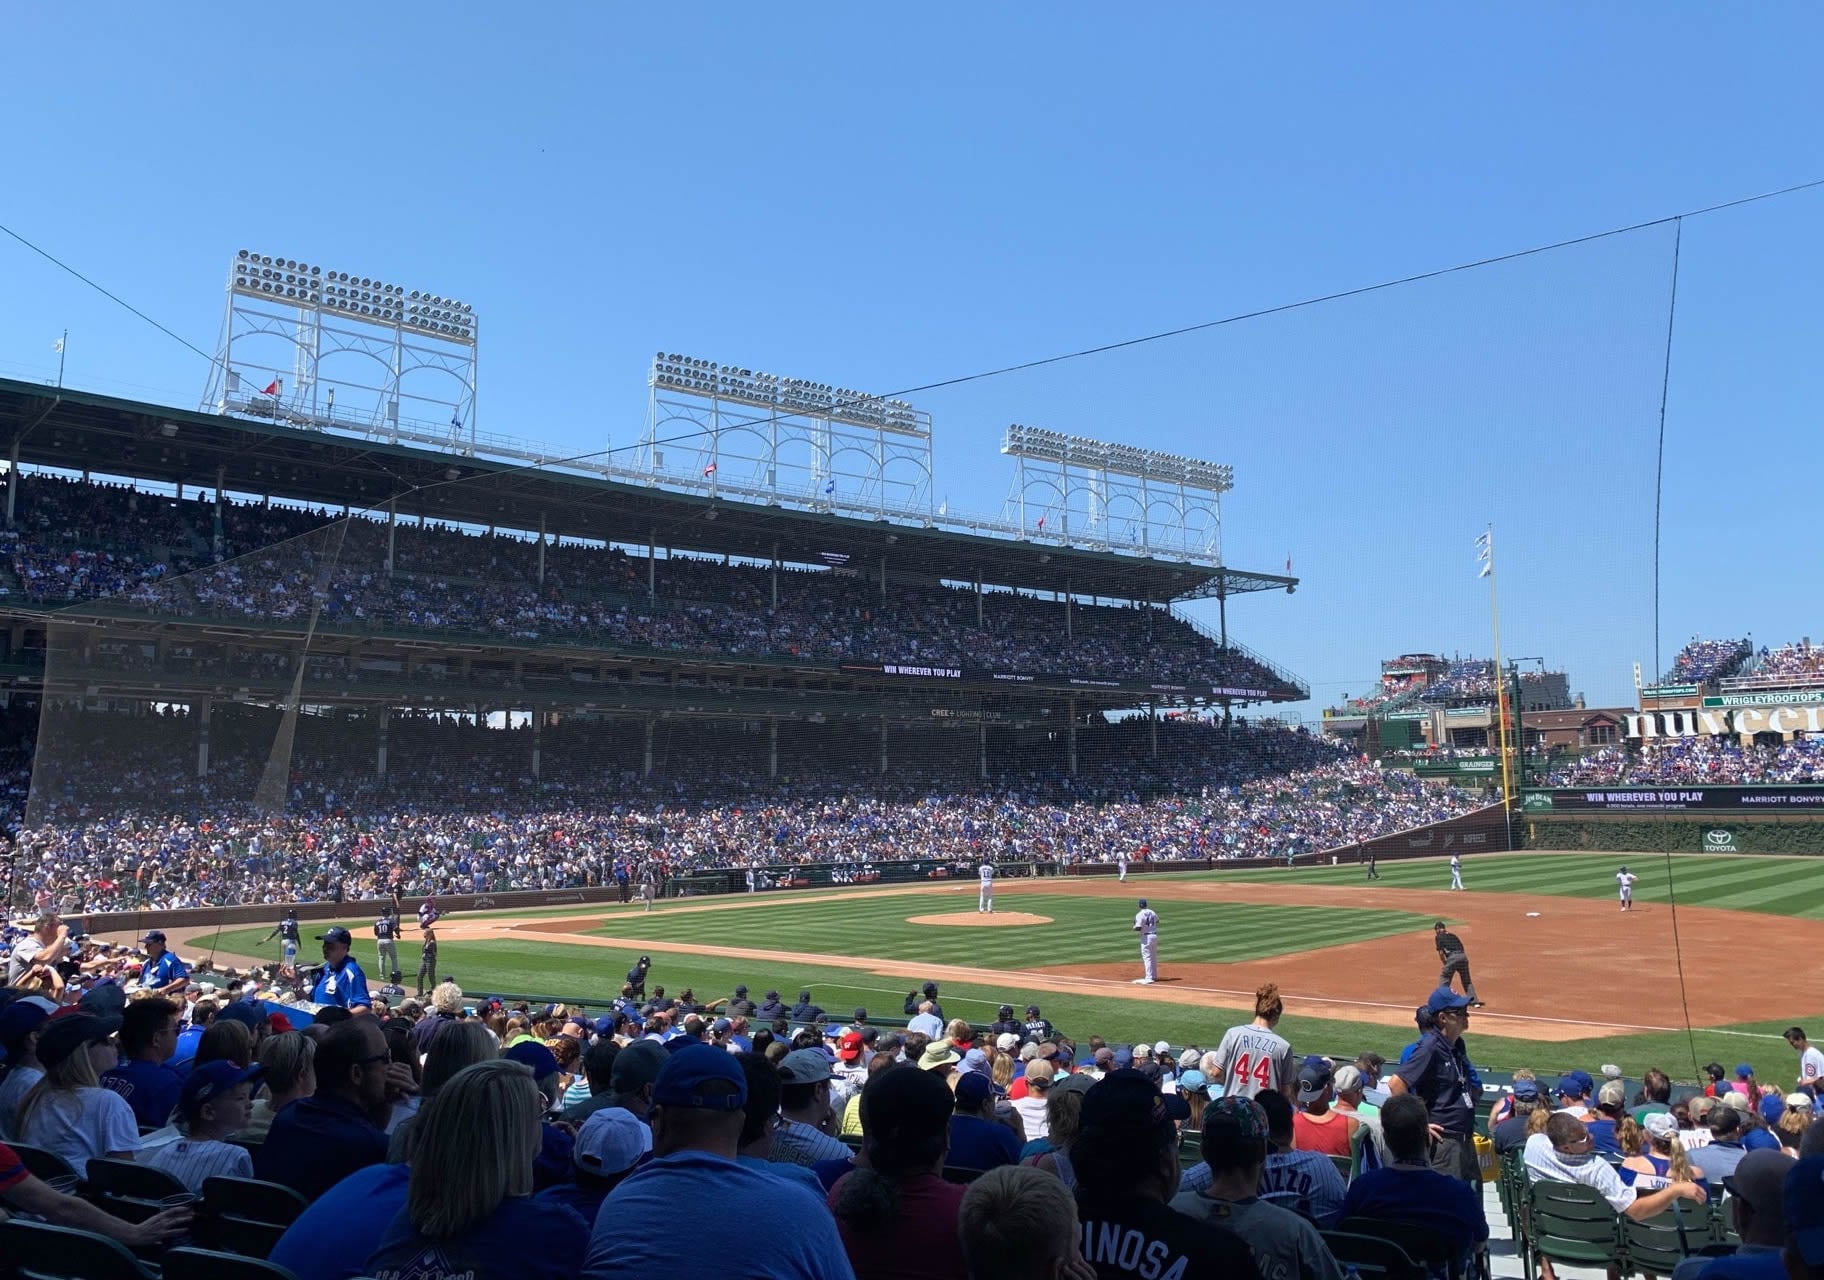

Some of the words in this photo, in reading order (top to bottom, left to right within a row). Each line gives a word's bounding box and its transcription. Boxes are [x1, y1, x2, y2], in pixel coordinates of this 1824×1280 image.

[884, 665, 897, 674] WIN
[898, 666, 932, 676] WHEREVER
[933, 668, 946, 677] YOU
[946, 669, 961, 678] PLAY
[1586, 792, 1605, 802] WIN
[1606, 792, 1656, 802] WHEREVER
[1658, 792, 1677, 802] YOU
[1680, 792, 1703, 802] PLAY
[1741, 795, 1787, 803] MARRIOTT
[283, 925, 288, 934] 2
[378, 924, 388, 933] 10
[1242, 1035, 1278, 1054] RIZZO
[1233, 1051, 1271, 1090] 44
